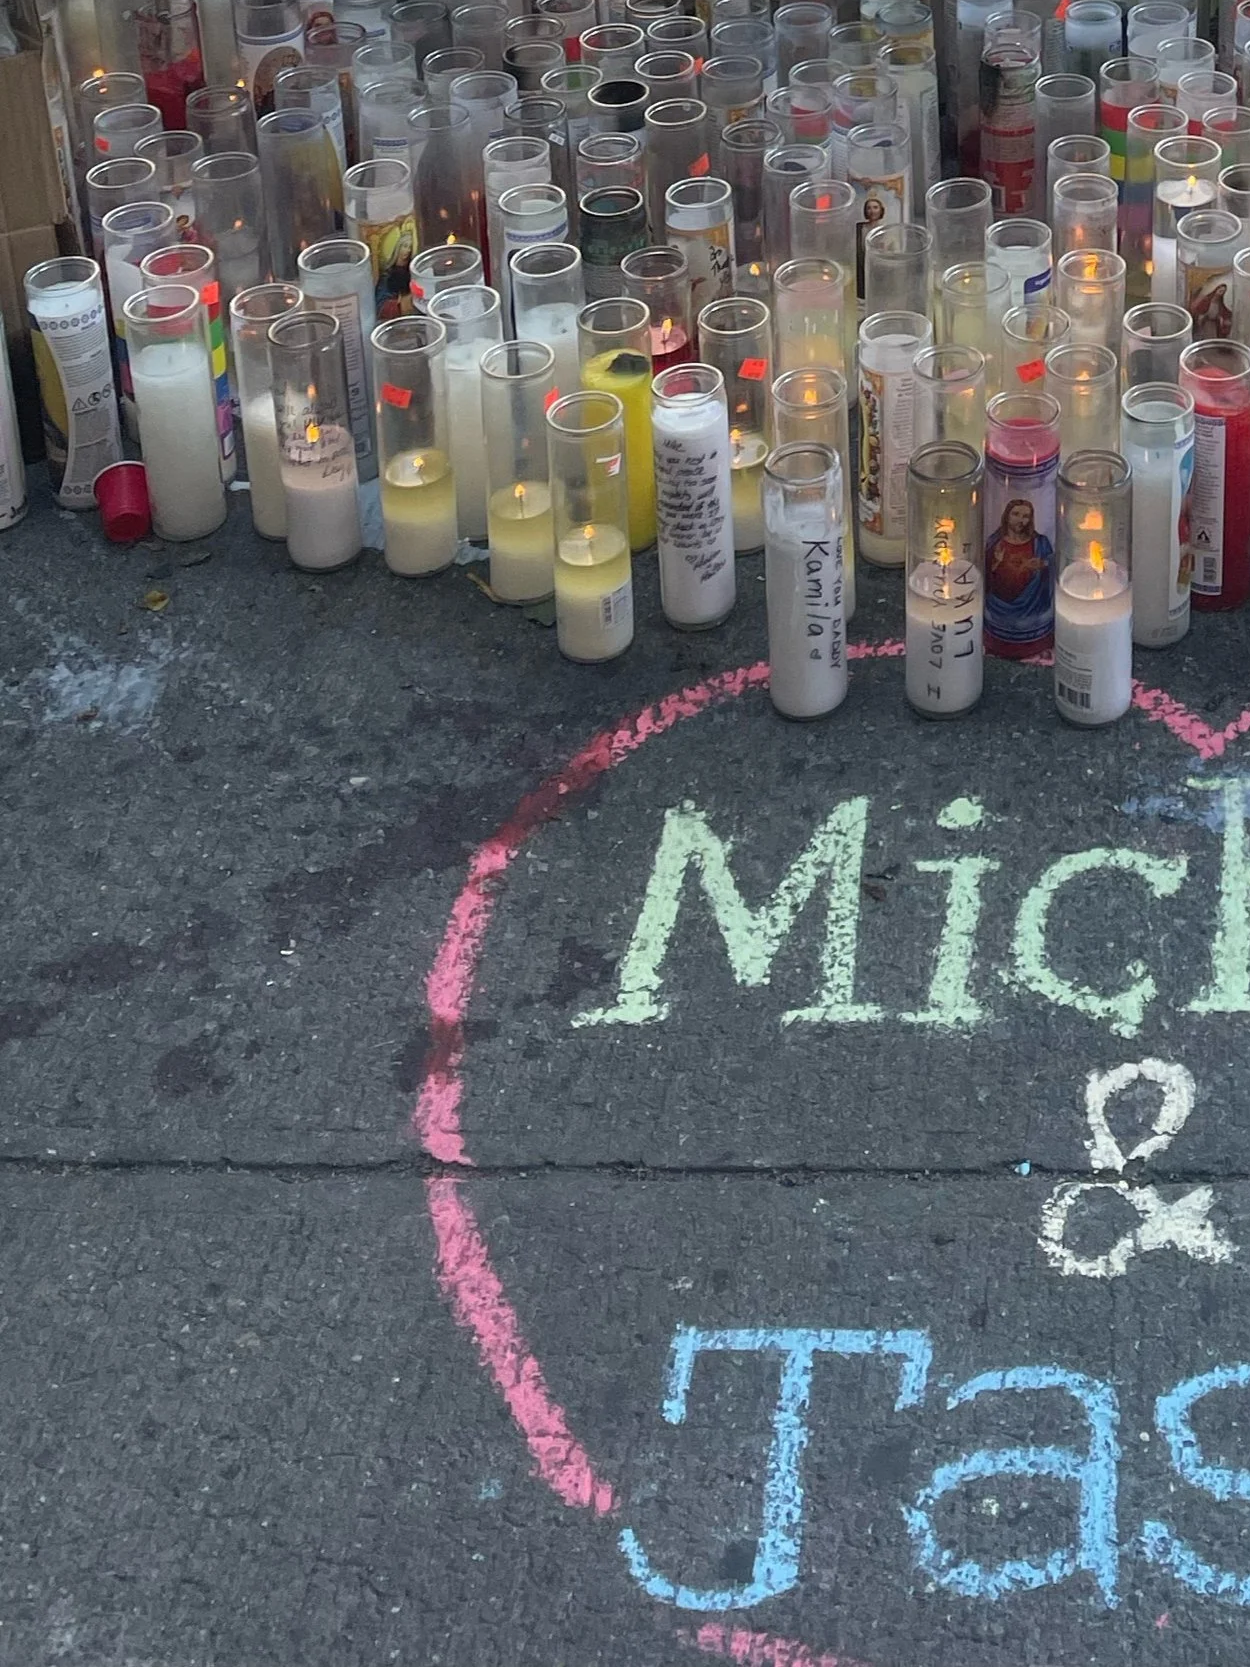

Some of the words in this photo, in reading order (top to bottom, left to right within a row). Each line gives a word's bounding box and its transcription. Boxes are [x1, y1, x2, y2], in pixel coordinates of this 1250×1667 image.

[801, 540, 832, 637] Kamila
[953, 564, 975, 659] LUKA
[929, 619, 947, 670] LOVE
[1037, 1056, 1238, 1278] &
